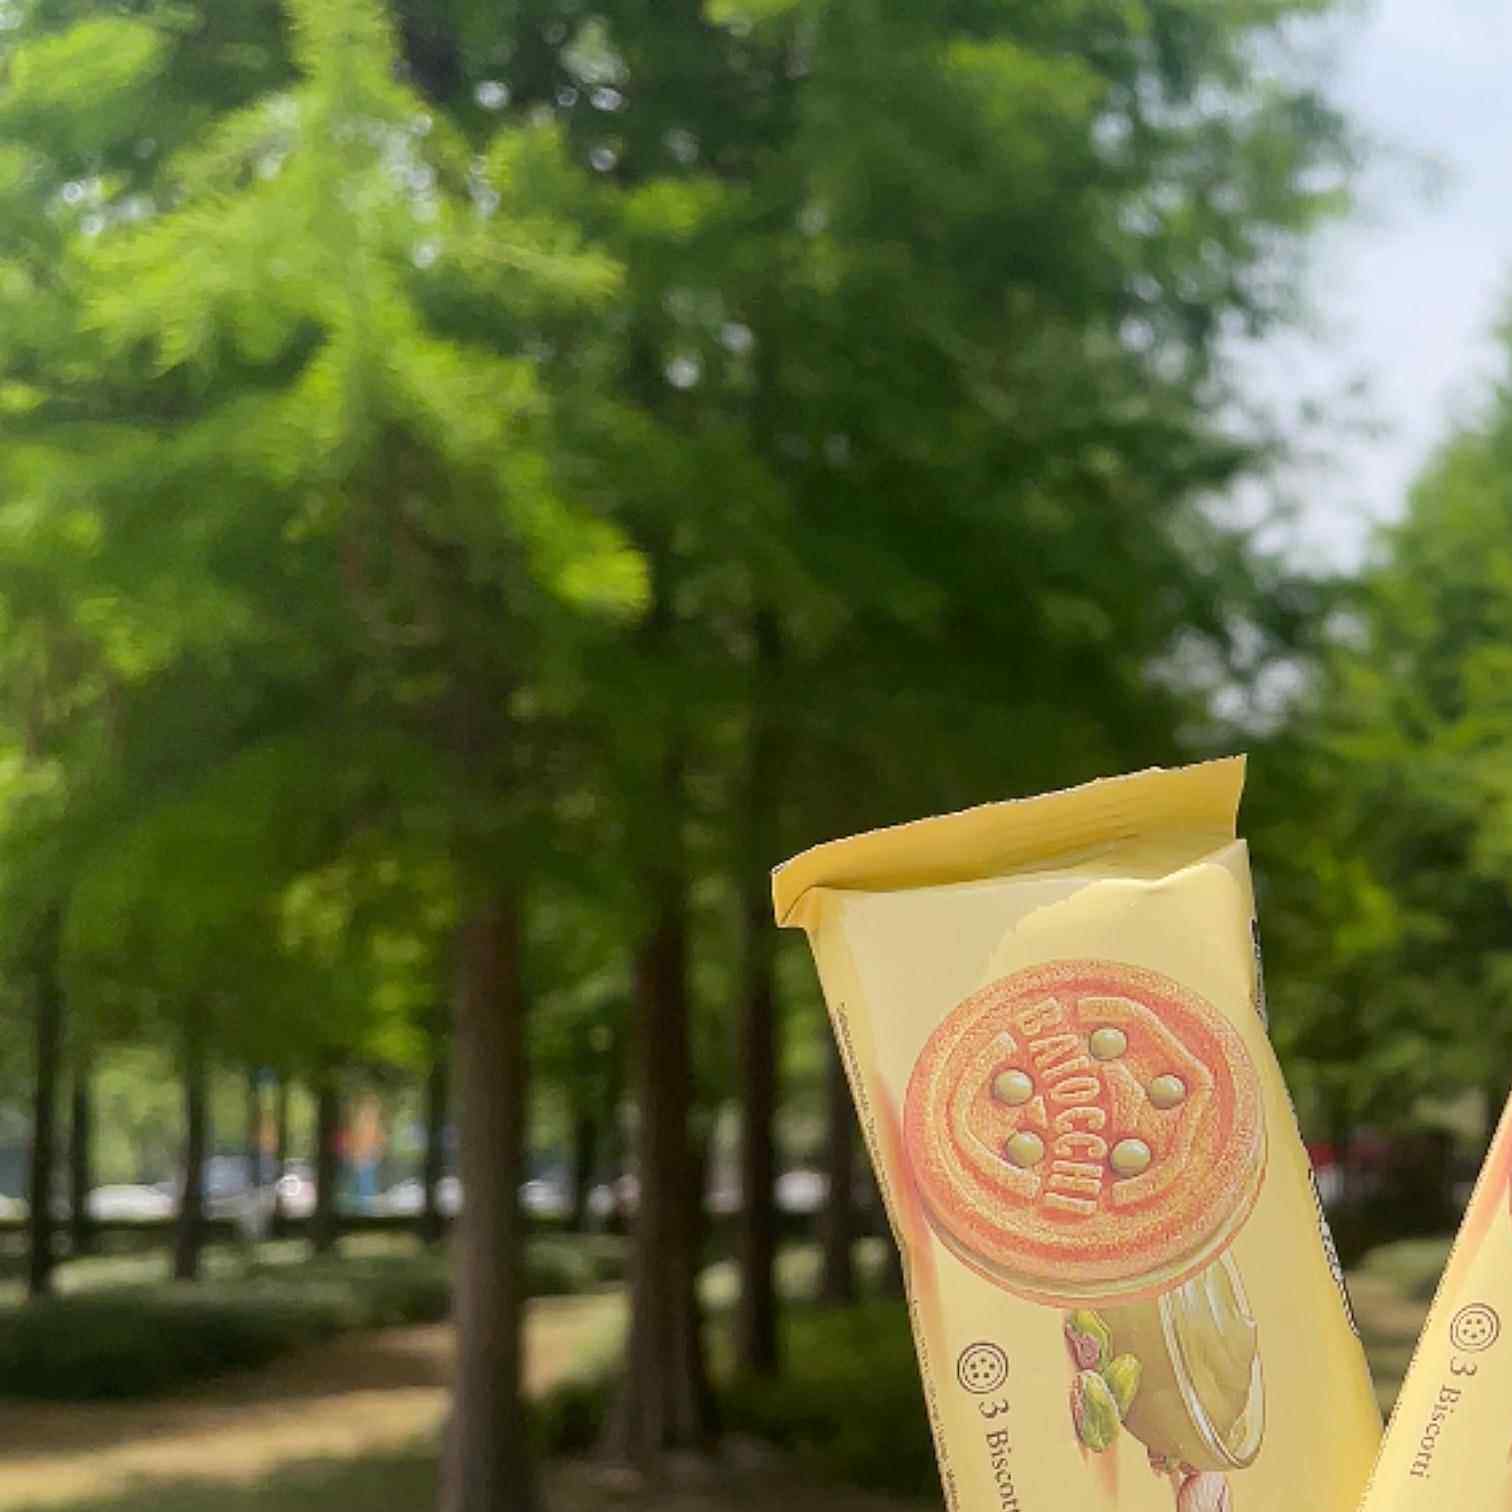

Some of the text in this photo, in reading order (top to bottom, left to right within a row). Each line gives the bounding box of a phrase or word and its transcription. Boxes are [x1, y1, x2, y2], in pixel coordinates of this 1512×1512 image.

[1014, 996, 1109, 1216] BAIOCCHI
[978, 1398, 1010, 1420] 3
[1409, 1356, 1478, 1479] 3 Biscotti
